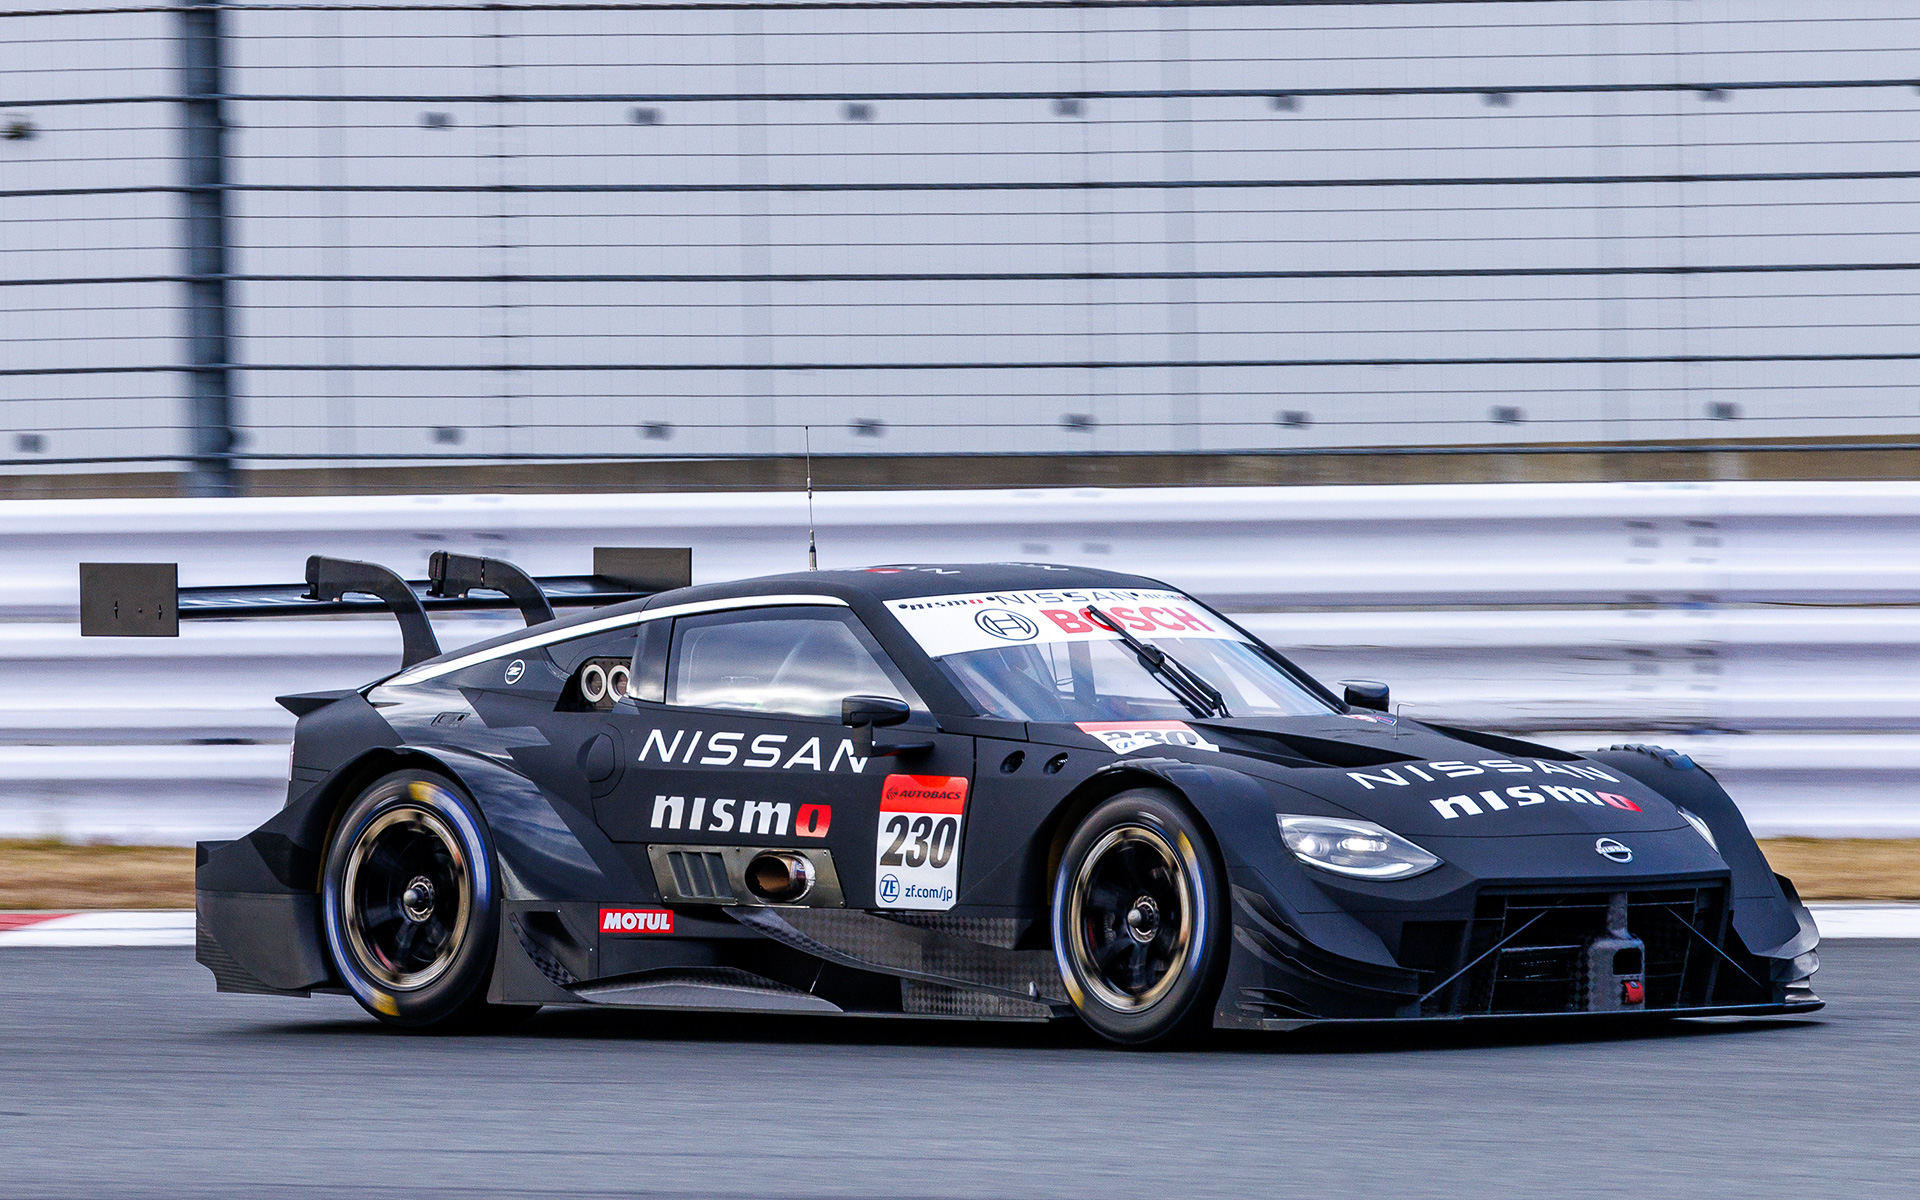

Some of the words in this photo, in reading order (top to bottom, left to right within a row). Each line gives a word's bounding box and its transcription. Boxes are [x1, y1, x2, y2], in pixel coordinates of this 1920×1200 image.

[910, 599, 984, 611] nismo
[993, 590, 1135, 605] NISSAN
[1040, 605, 1217, 634] BOSCH
[637, 729, 877, 774] NISSAN
[1345, 759, 1621, 790] NISSAN
[899, 790, 962, 800] AUTOBACS
[1429, 784, 1643, 820] nismo
[650, 794, 832, 838] nismo
[879, 814, 958, 869] 230
[880, 879, 899, 898] ZF
[904, 884, 953, 902] zf.com/jp
[603, 912, 671, 931] MOTUL
